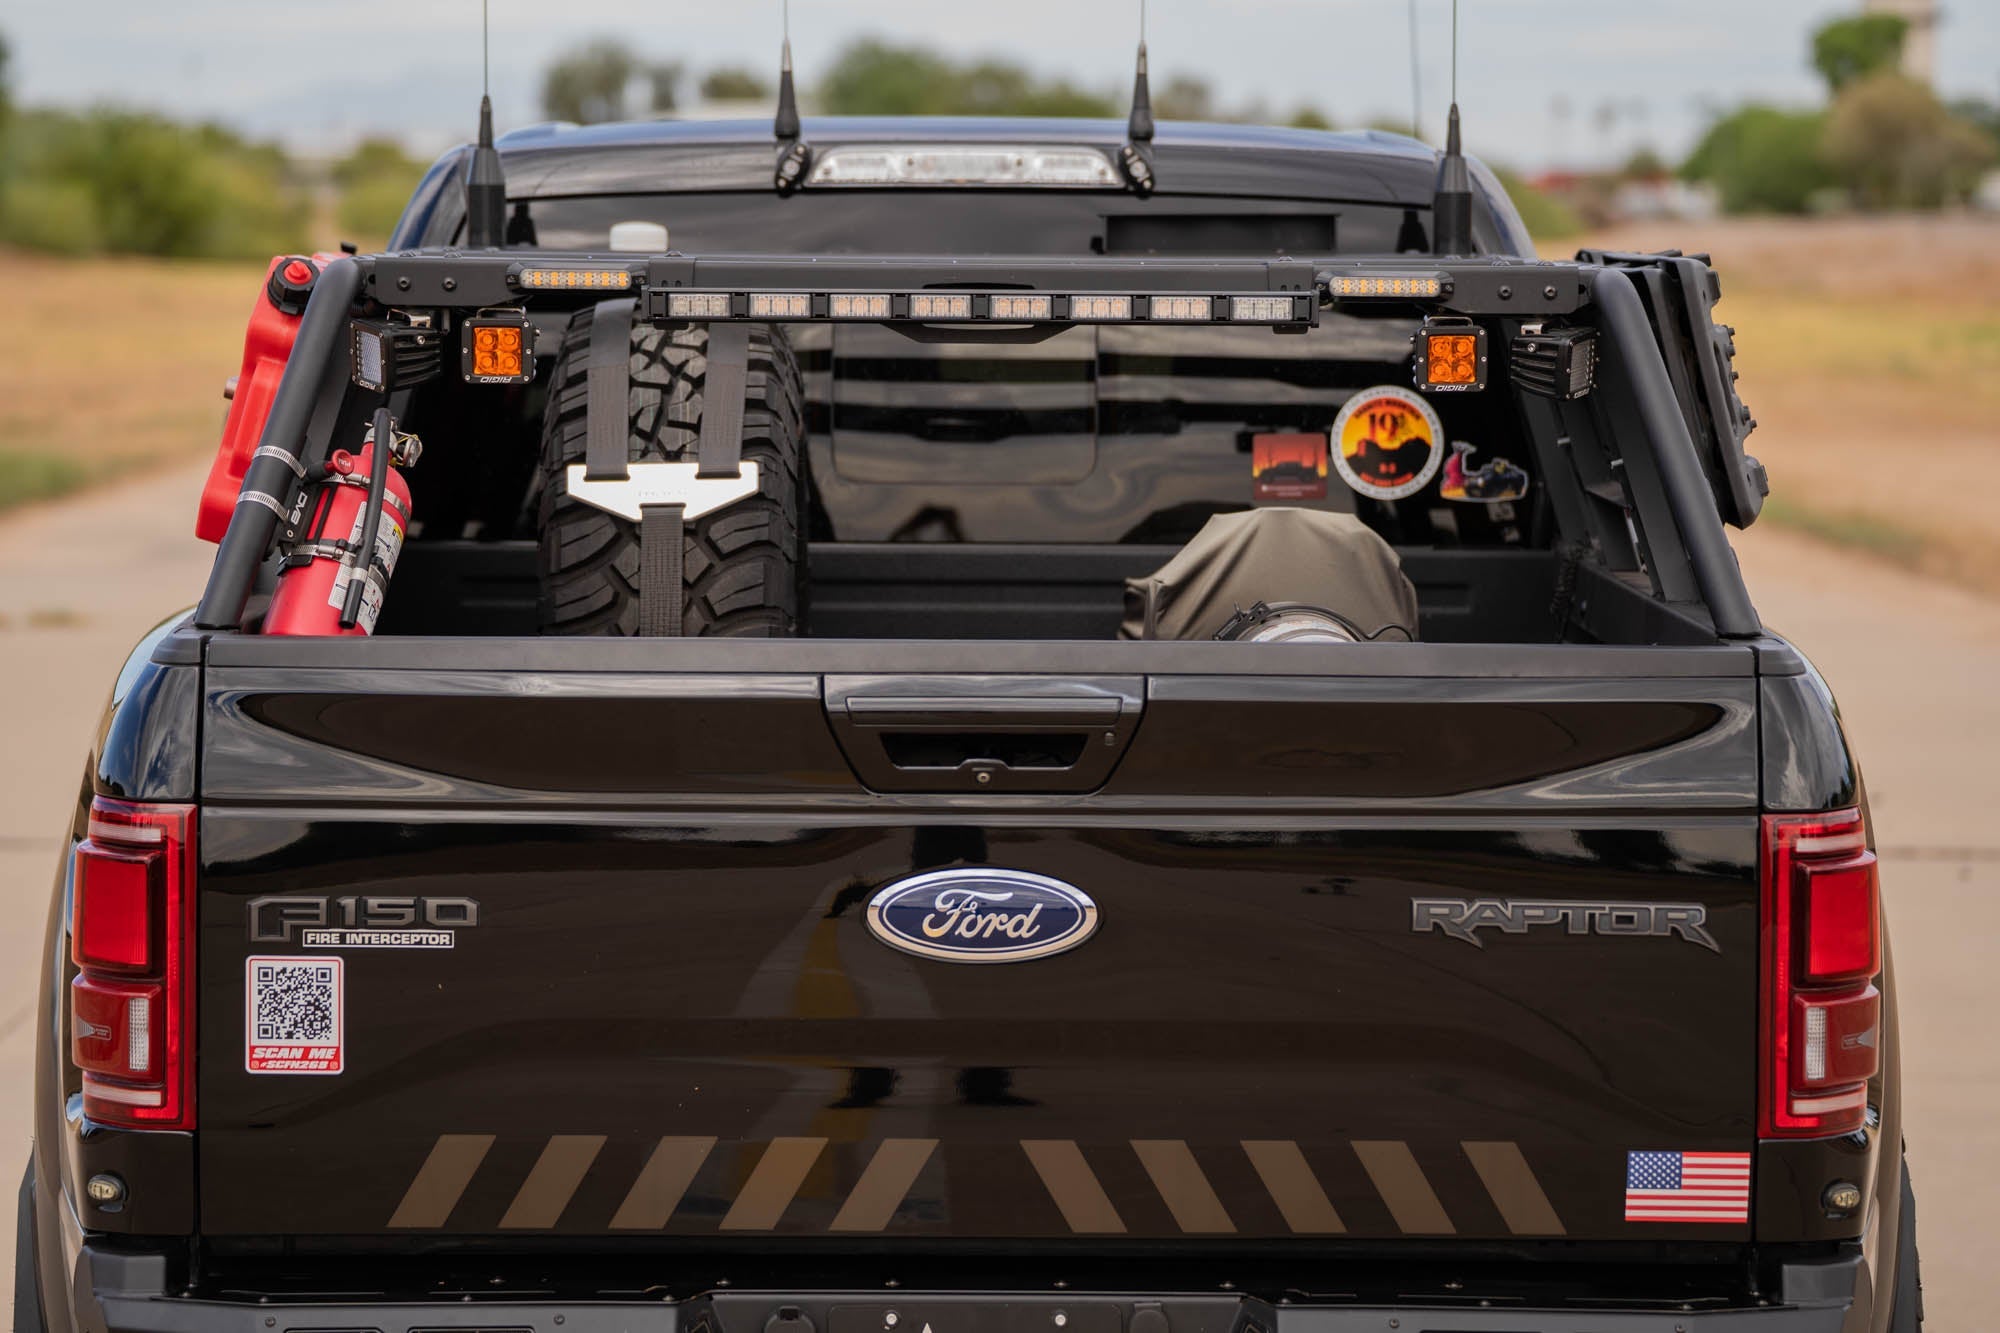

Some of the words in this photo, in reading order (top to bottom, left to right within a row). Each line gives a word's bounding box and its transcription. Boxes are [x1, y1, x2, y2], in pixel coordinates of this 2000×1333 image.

[479, 376, 513, 384] RIGID
[290, 491, 308, 525] DV8
[922, 889, 1044, 939] Ford
[1411, 898, 1721, 952] RAPTOR
[306, 933, 340, 944] FIRE
[345, 933, 451, 945] INTERCEPTOR
[252, 1047, 304, 1059] SCAN
[308, 1047, 336, 1059] ME
